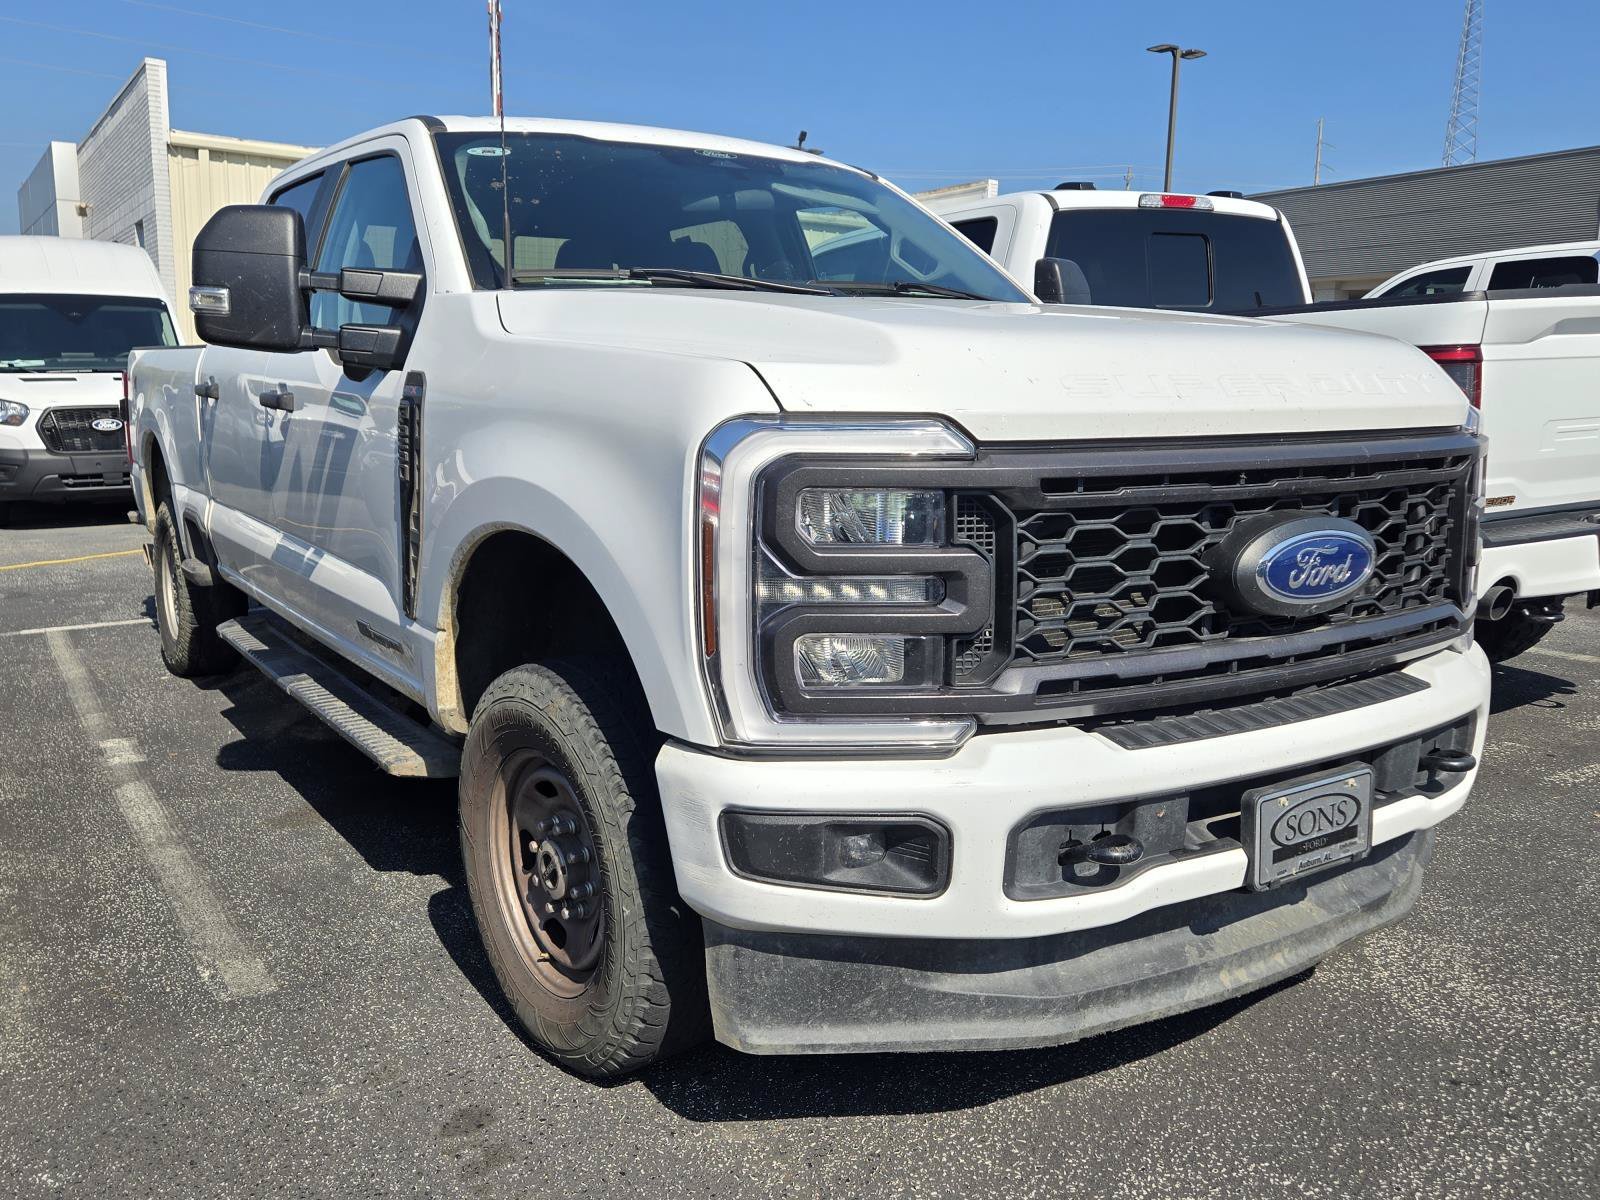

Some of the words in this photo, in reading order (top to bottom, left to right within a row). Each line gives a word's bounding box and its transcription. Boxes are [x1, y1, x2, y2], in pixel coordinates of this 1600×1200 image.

[1058, 373, 1300, 398] SUPER
[1307, 371, 1435, 396] DUTY
[1289, 545, 1353, 589] Ford
[1285, 800, 1348, 841] SONS
[1305, 838, 1328, 851] FORD
[1324, 853, 1333, 863] AL
